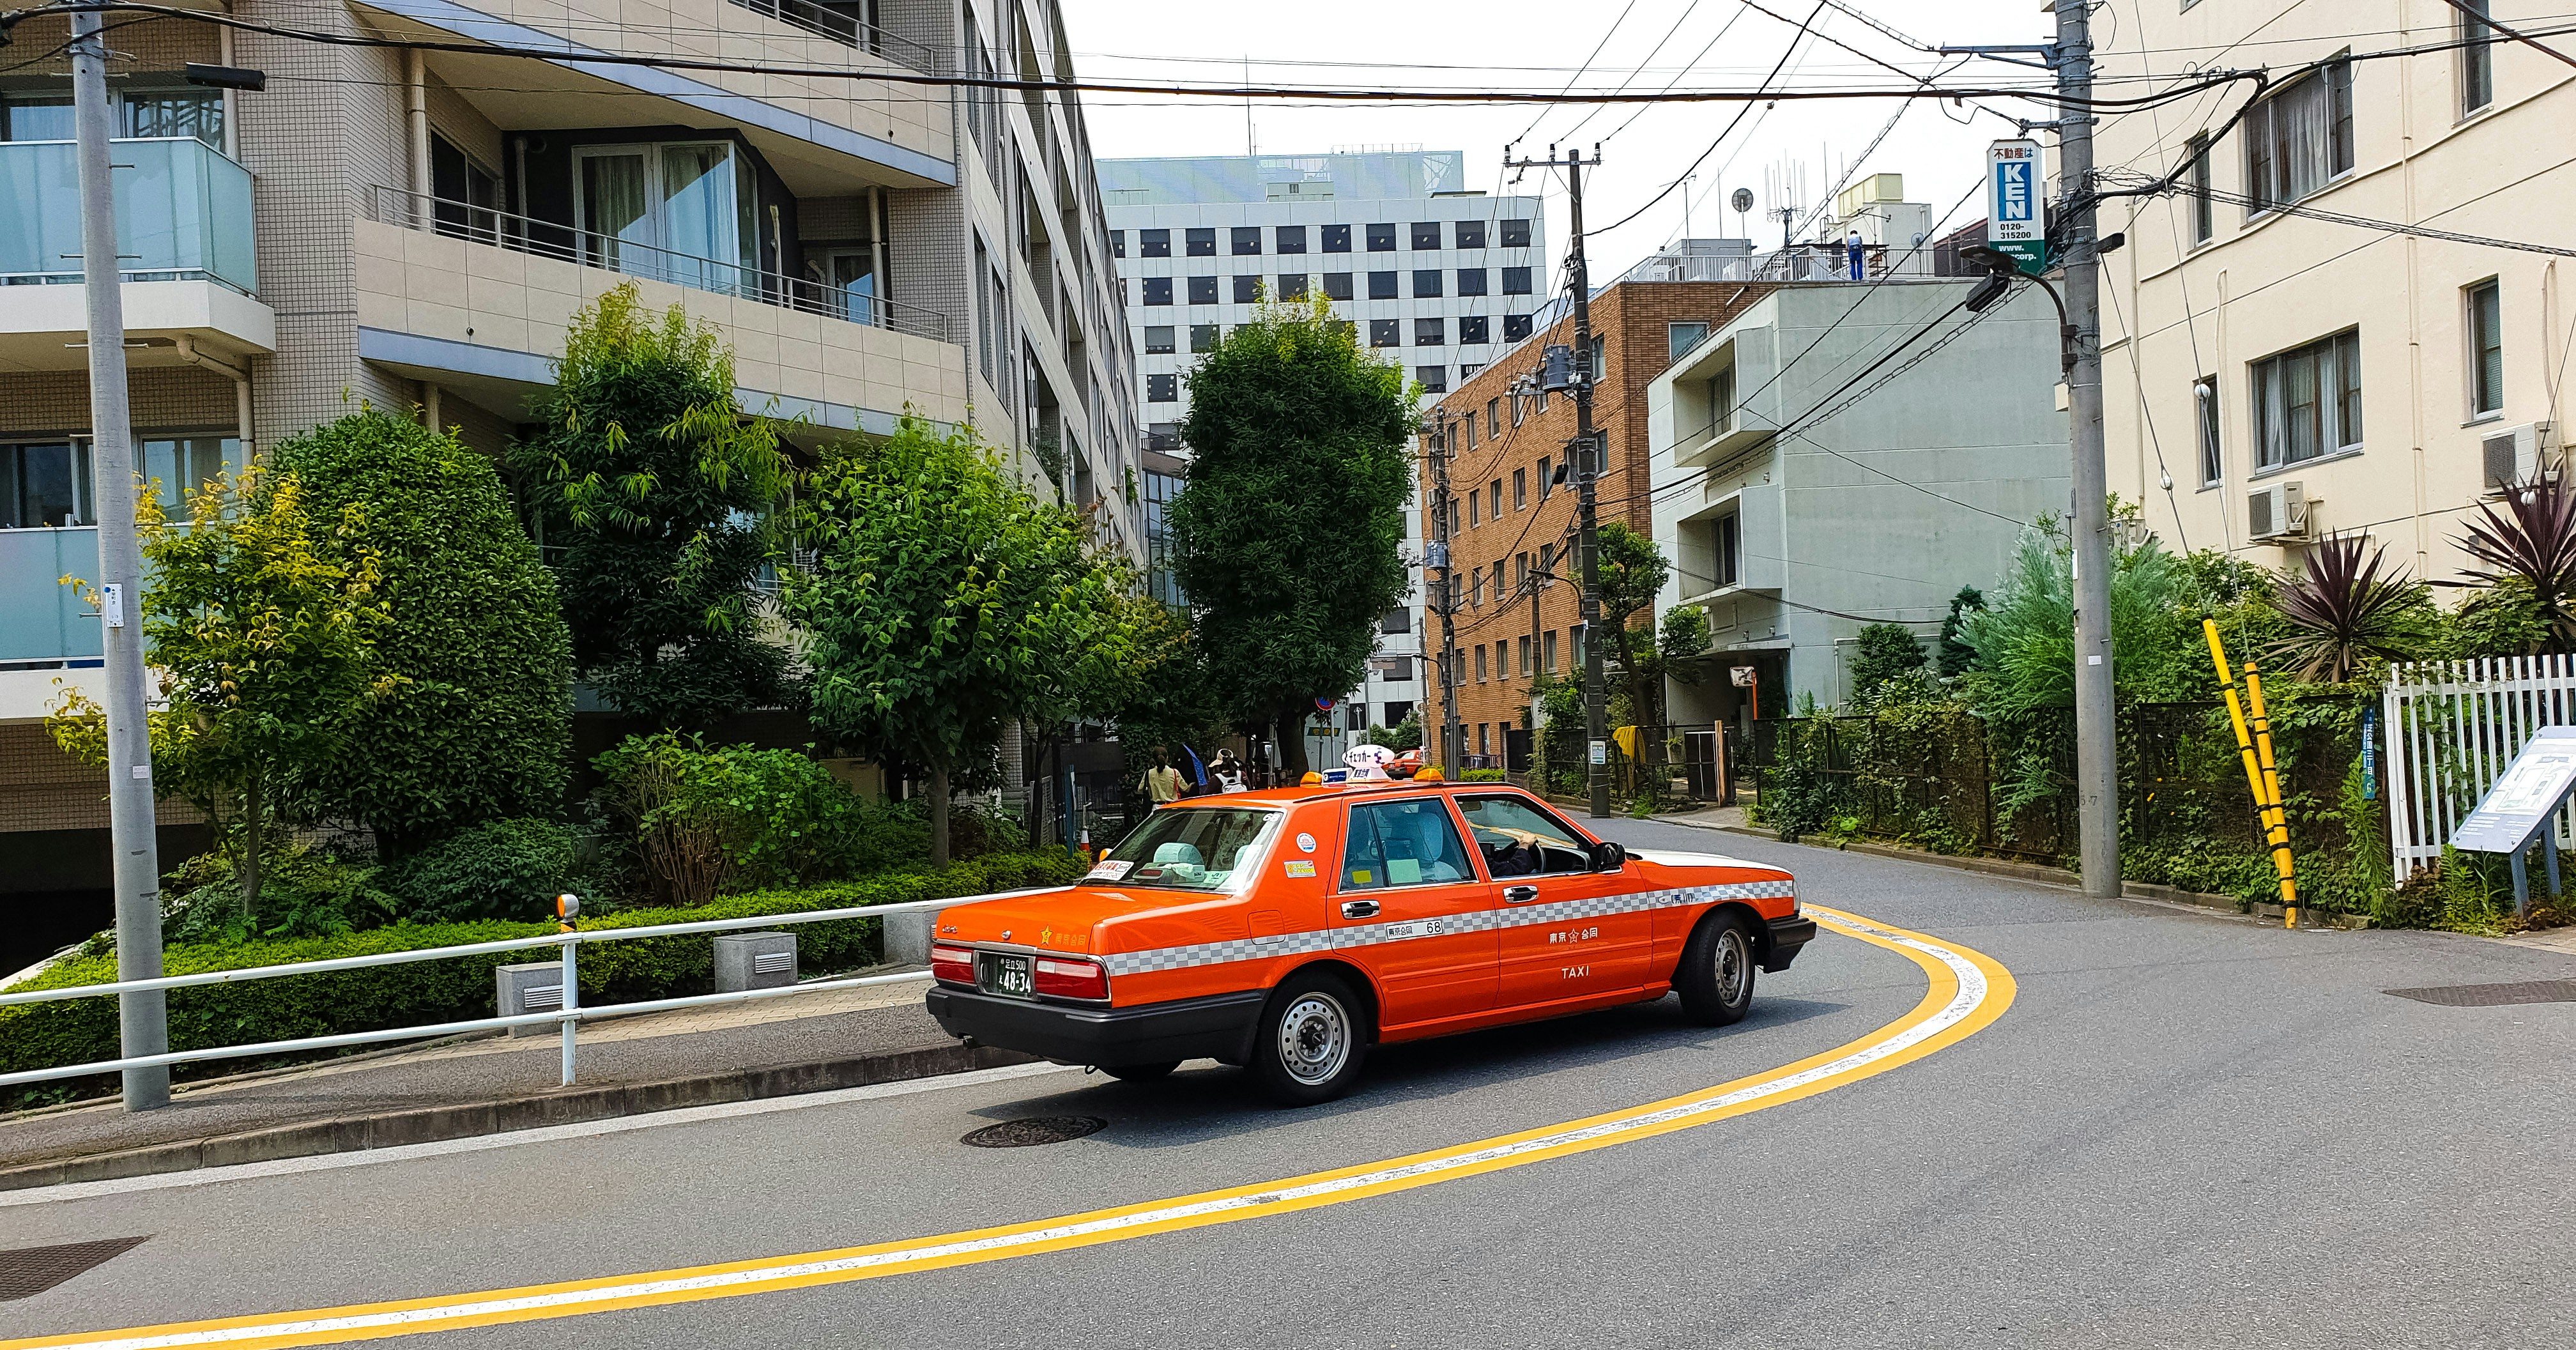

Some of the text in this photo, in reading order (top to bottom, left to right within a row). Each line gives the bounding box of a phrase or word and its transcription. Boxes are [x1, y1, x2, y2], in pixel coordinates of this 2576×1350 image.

[1993, 148, 2034, 160] 不動産は
[2004, 164, 2026, 219] KEN
[1349, 750, 1371, 763] チェッカー
[1262, 812, 1281, 822] 68
[1388, 921, 1441, 937] 東京合同 68
[1549, 932, 1567, 944] 東京
[1581, 927, 1598, 940] 合同
[1561, 965, 1590, 979] TAXI
[1004, 970, 1031, 993] 48-34
